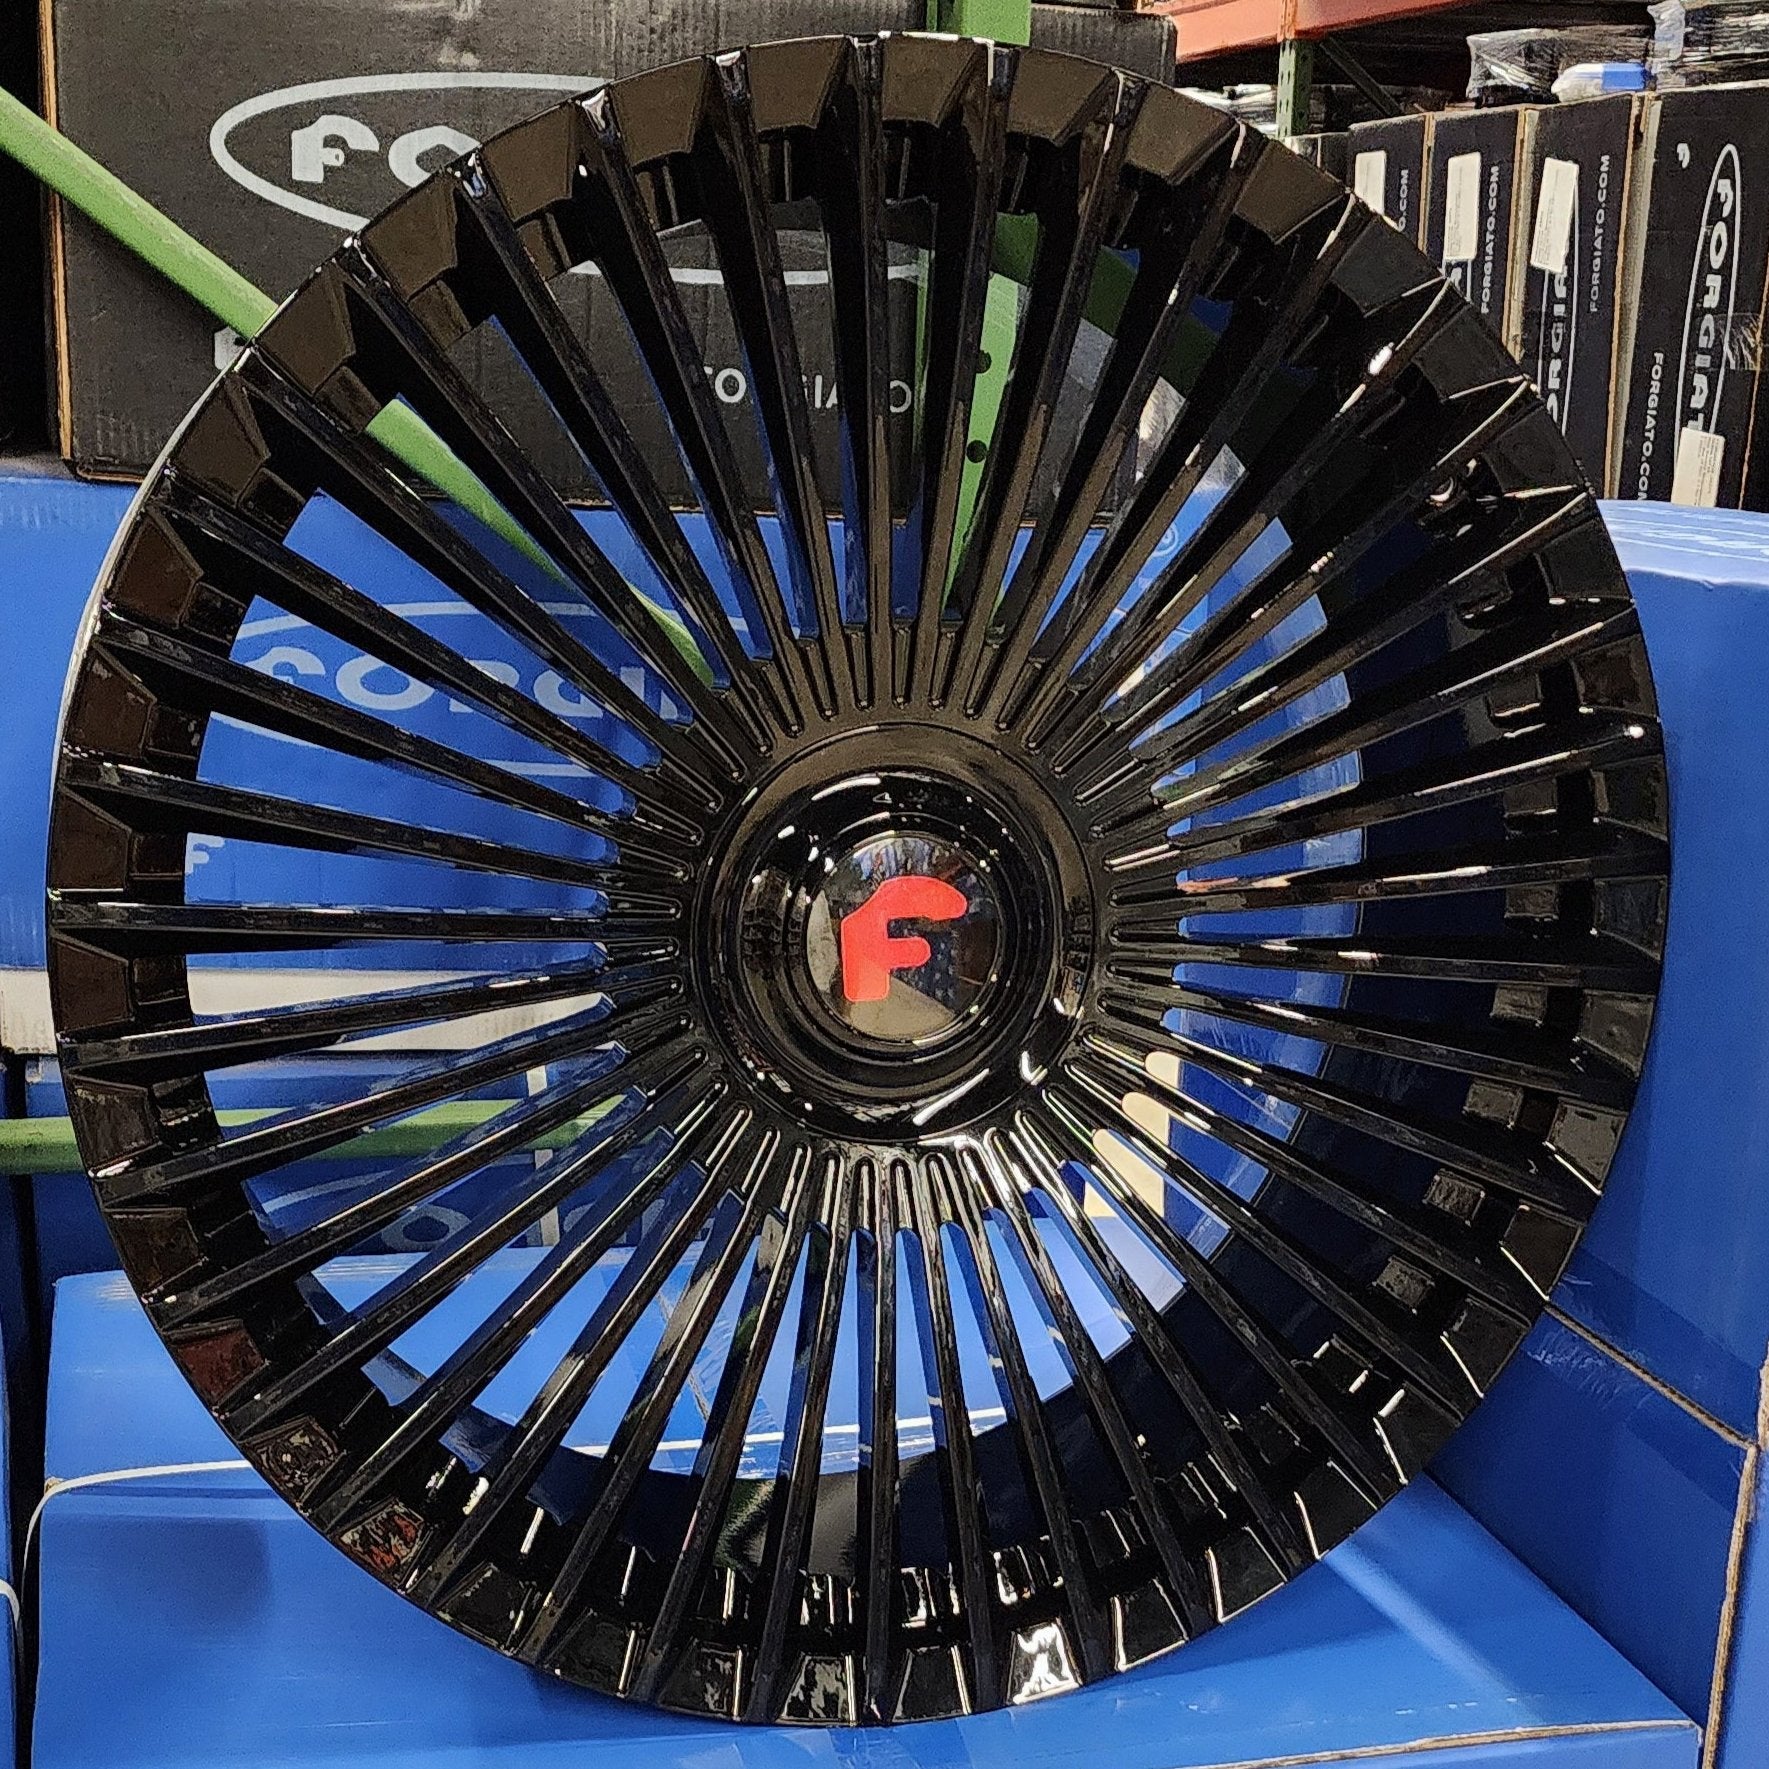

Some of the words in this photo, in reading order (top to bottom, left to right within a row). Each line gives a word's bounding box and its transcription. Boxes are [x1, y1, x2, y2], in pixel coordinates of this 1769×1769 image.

[1480, 165, 1500, 314] FORGIATO.COM
[1588, 154, 1610, 313] FORGIATO.COM
[841, 875, 968, 1002] F
